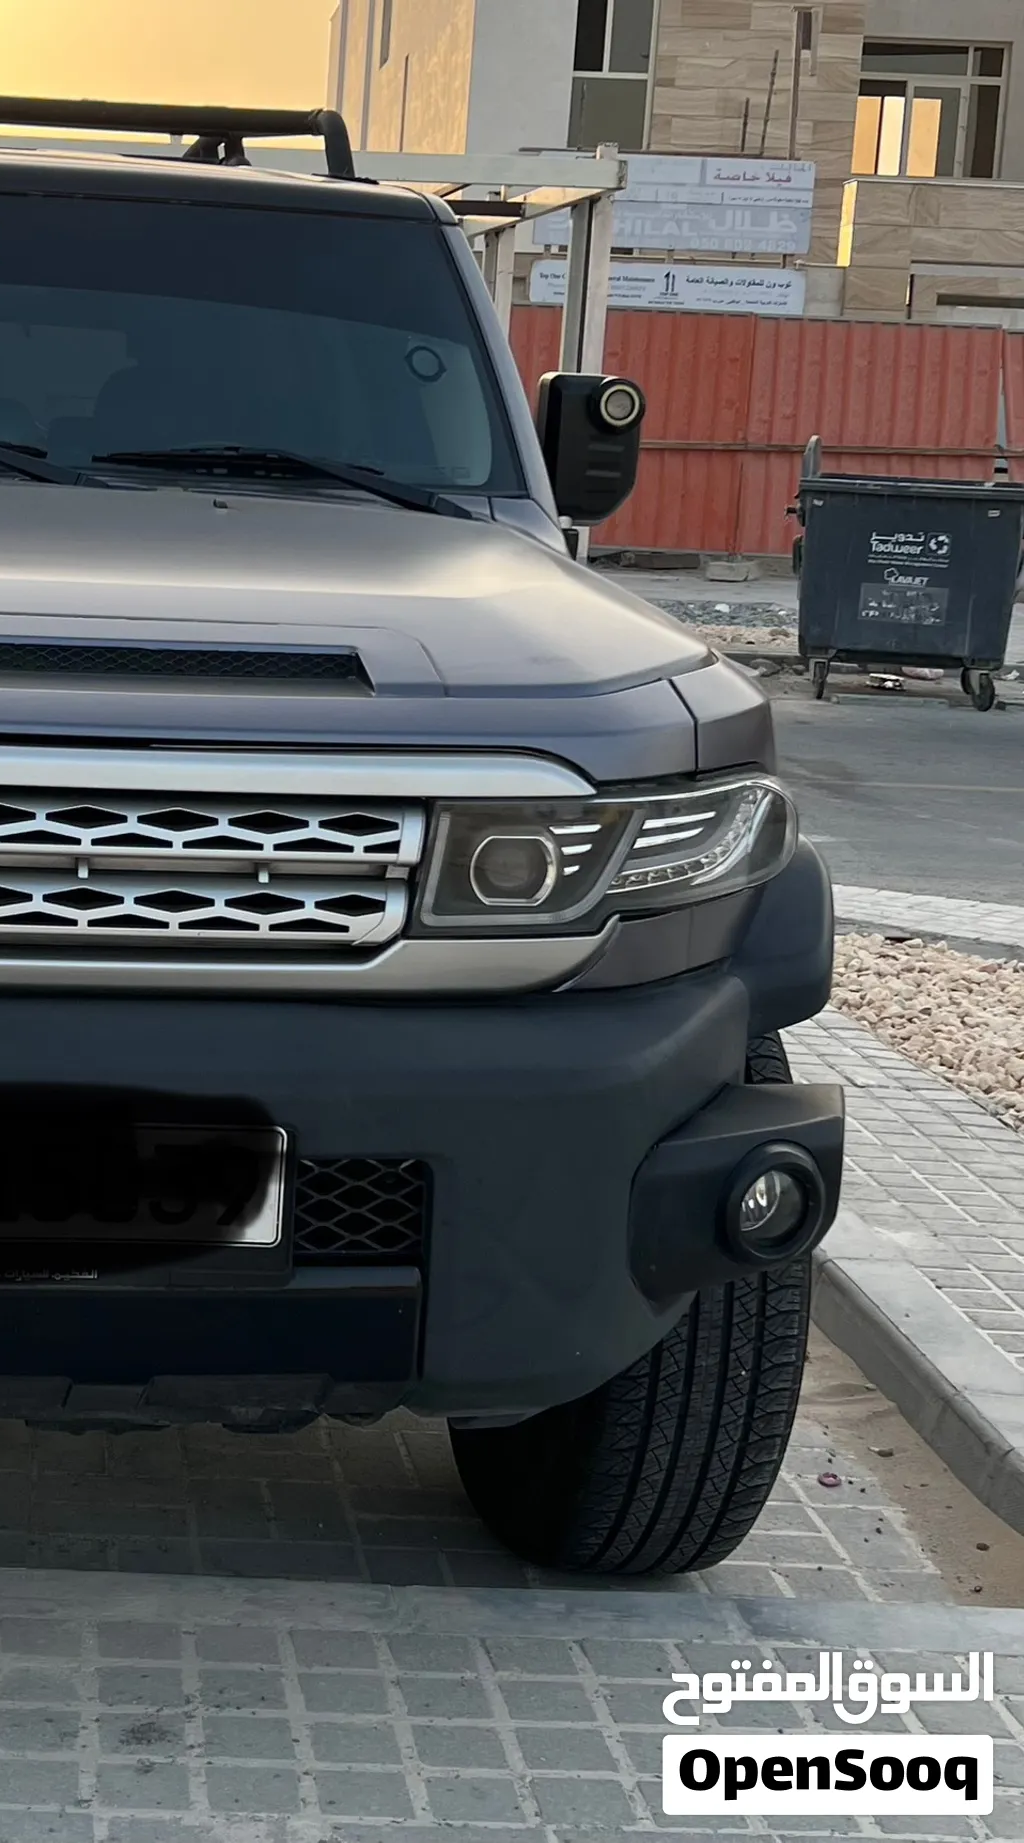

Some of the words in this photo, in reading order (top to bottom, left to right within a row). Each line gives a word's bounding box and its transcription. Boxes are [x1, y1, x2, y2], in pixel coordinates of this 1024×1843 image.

[713, 167, 760, 181] خاصة
[765, 171, 792, 187] فيلا
[870, 531, 925, 543] تدوير
[870, 540, 925, 554] Tadweer
